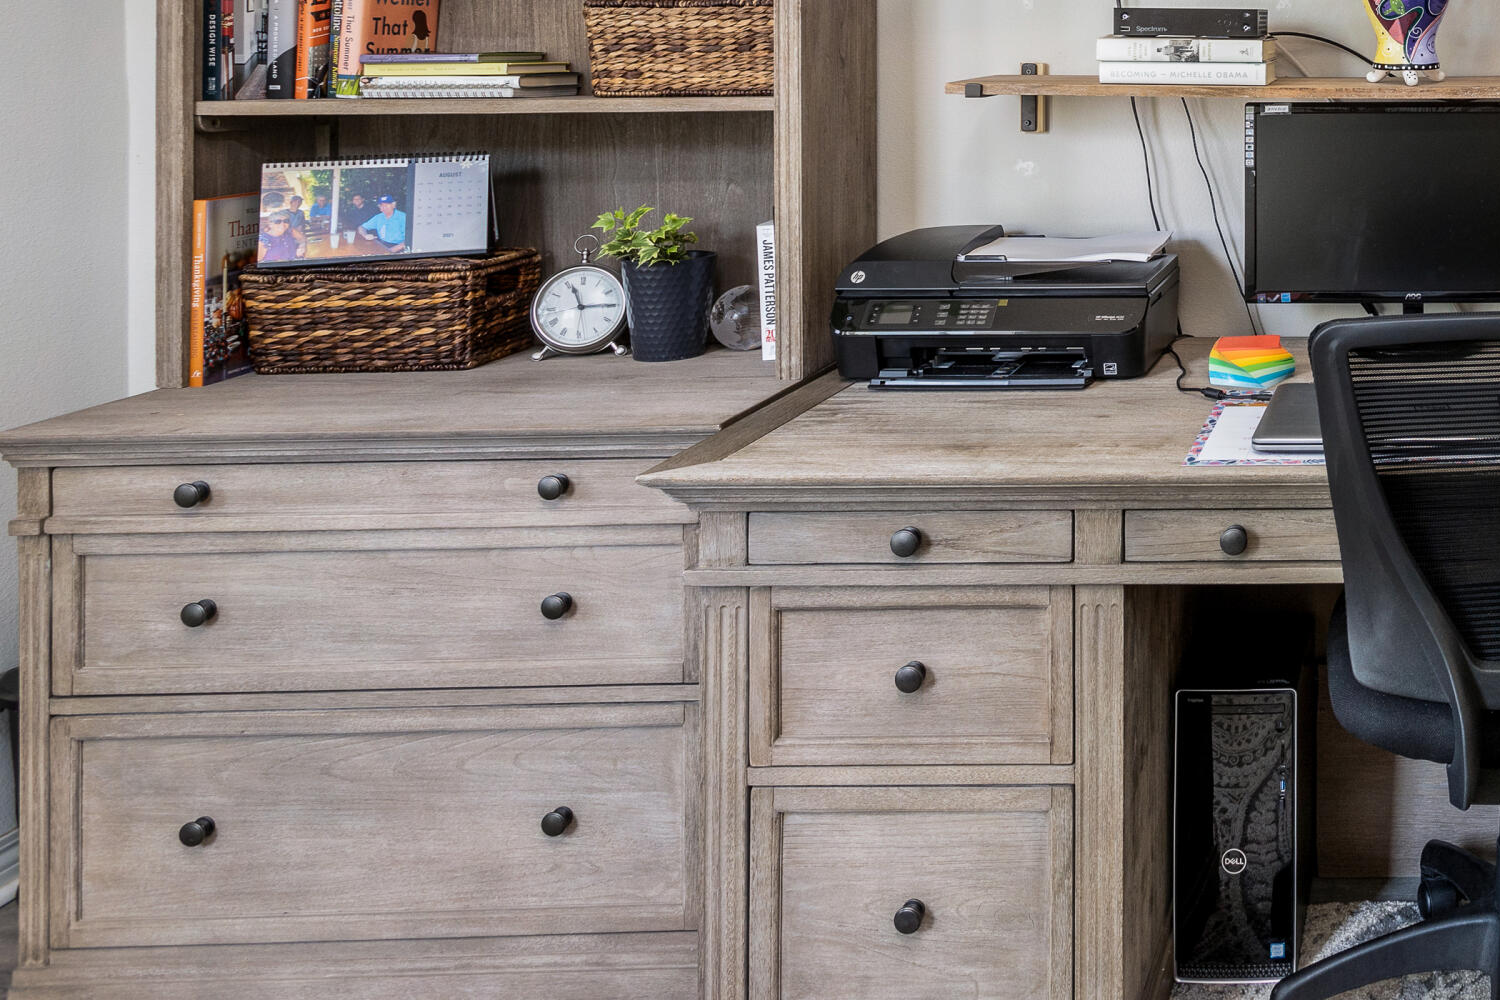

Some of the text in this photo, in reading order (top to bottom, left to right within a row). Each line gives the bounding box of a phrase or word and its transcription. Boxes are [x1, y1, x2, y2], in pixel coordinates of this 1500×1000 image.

[208, 14, 216, 44] DESIGN
[372, 16, 408, 36] That
[1136, 25, 1167, 33] Spectrum
[343, 15, 355, 71] That Summer
[366, 41, 431, 55] Summer
[208, 46, 216, 67] WISE
[1170, 71, 1213, 79] MICHELLE
[1216, 71, 1248, 79] OBAMA
[228, 220, 259, 239] Than
[192, 253, 205, 308] Thanksgiving
[762, 240, 776, 326] JAMES PATTERSON
[1224, 857, 1244, 865] DELL
